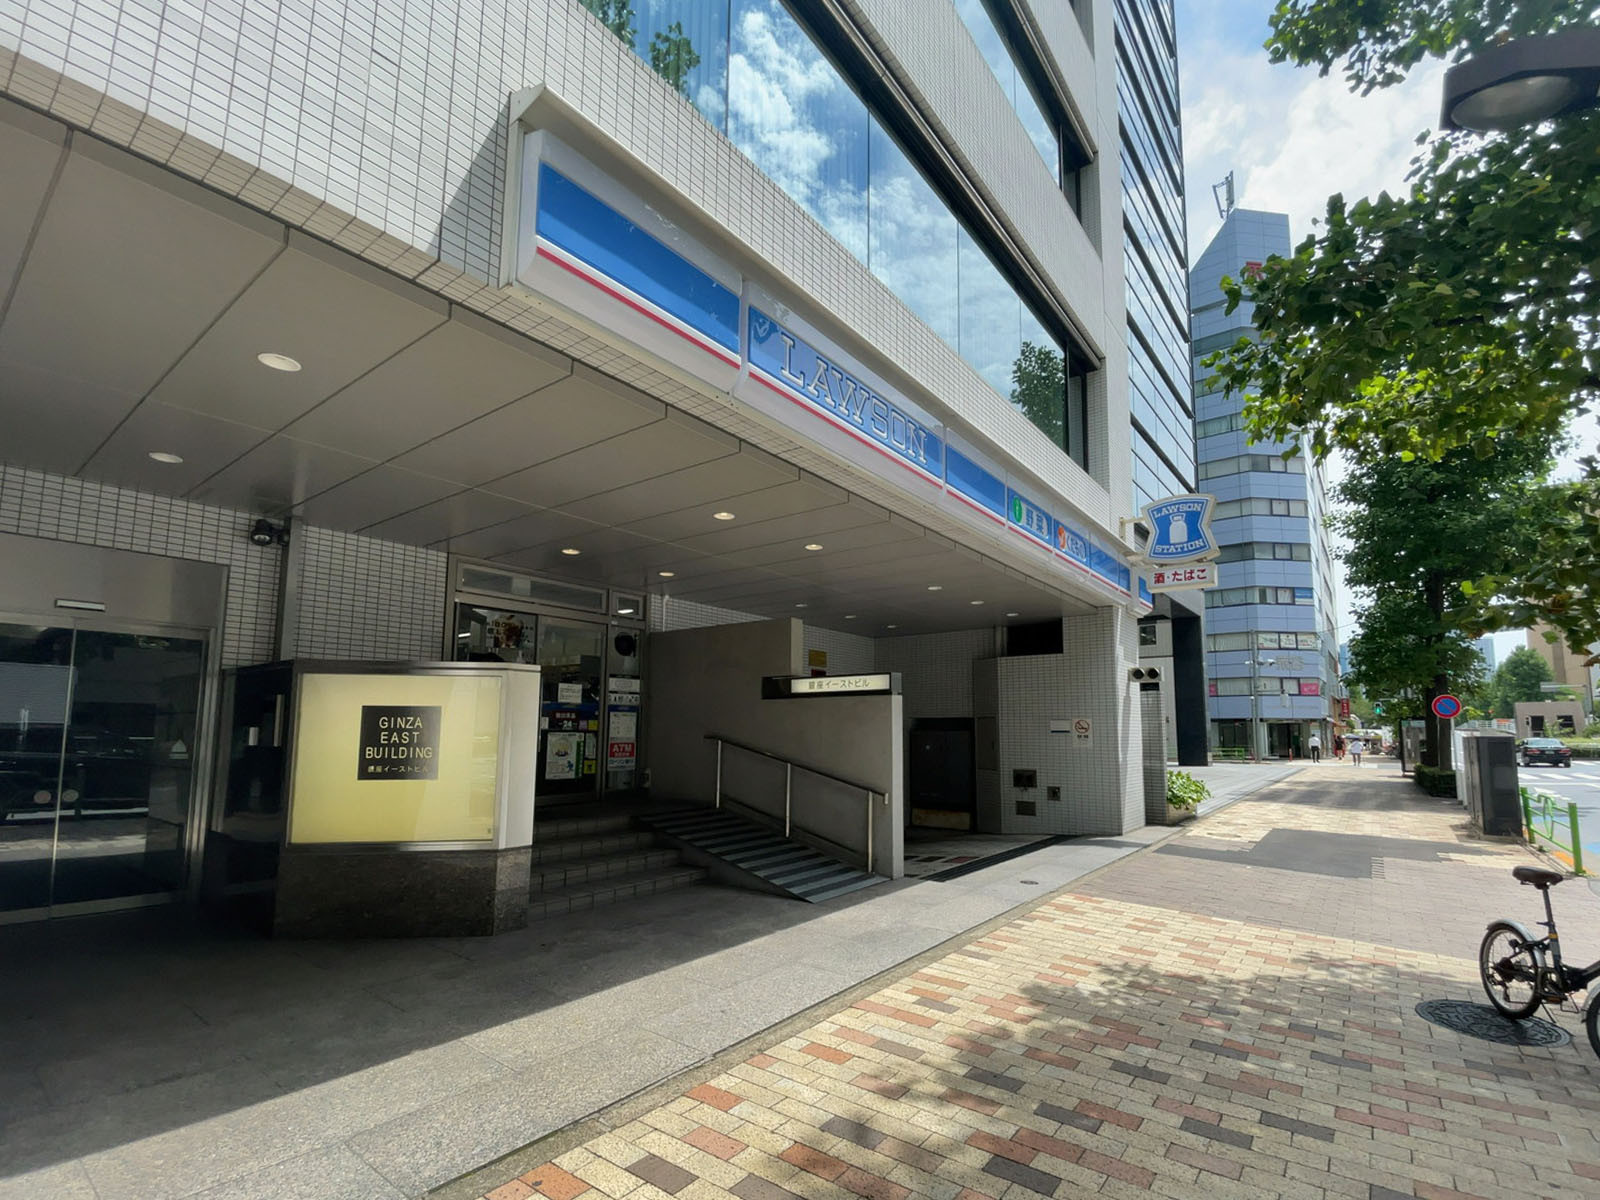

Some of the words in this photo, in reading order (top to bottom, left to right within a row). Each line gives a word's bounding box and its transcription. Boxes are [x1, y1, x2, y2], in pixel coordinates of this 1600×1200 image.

[780, 331, 928, 465] LAWSON
[1153, 503, 1202, 518] LAWSON
[1154, 538, 1205, 553] STATION
[1153, 568, 1207, 585] 酒・たばこ
[379, 716, 423, 729] GINZA
[380, 731, 420, 744] EAST
[365, 746, 433, 759] BUILDING
[612, 744, 633, 753] ATM
